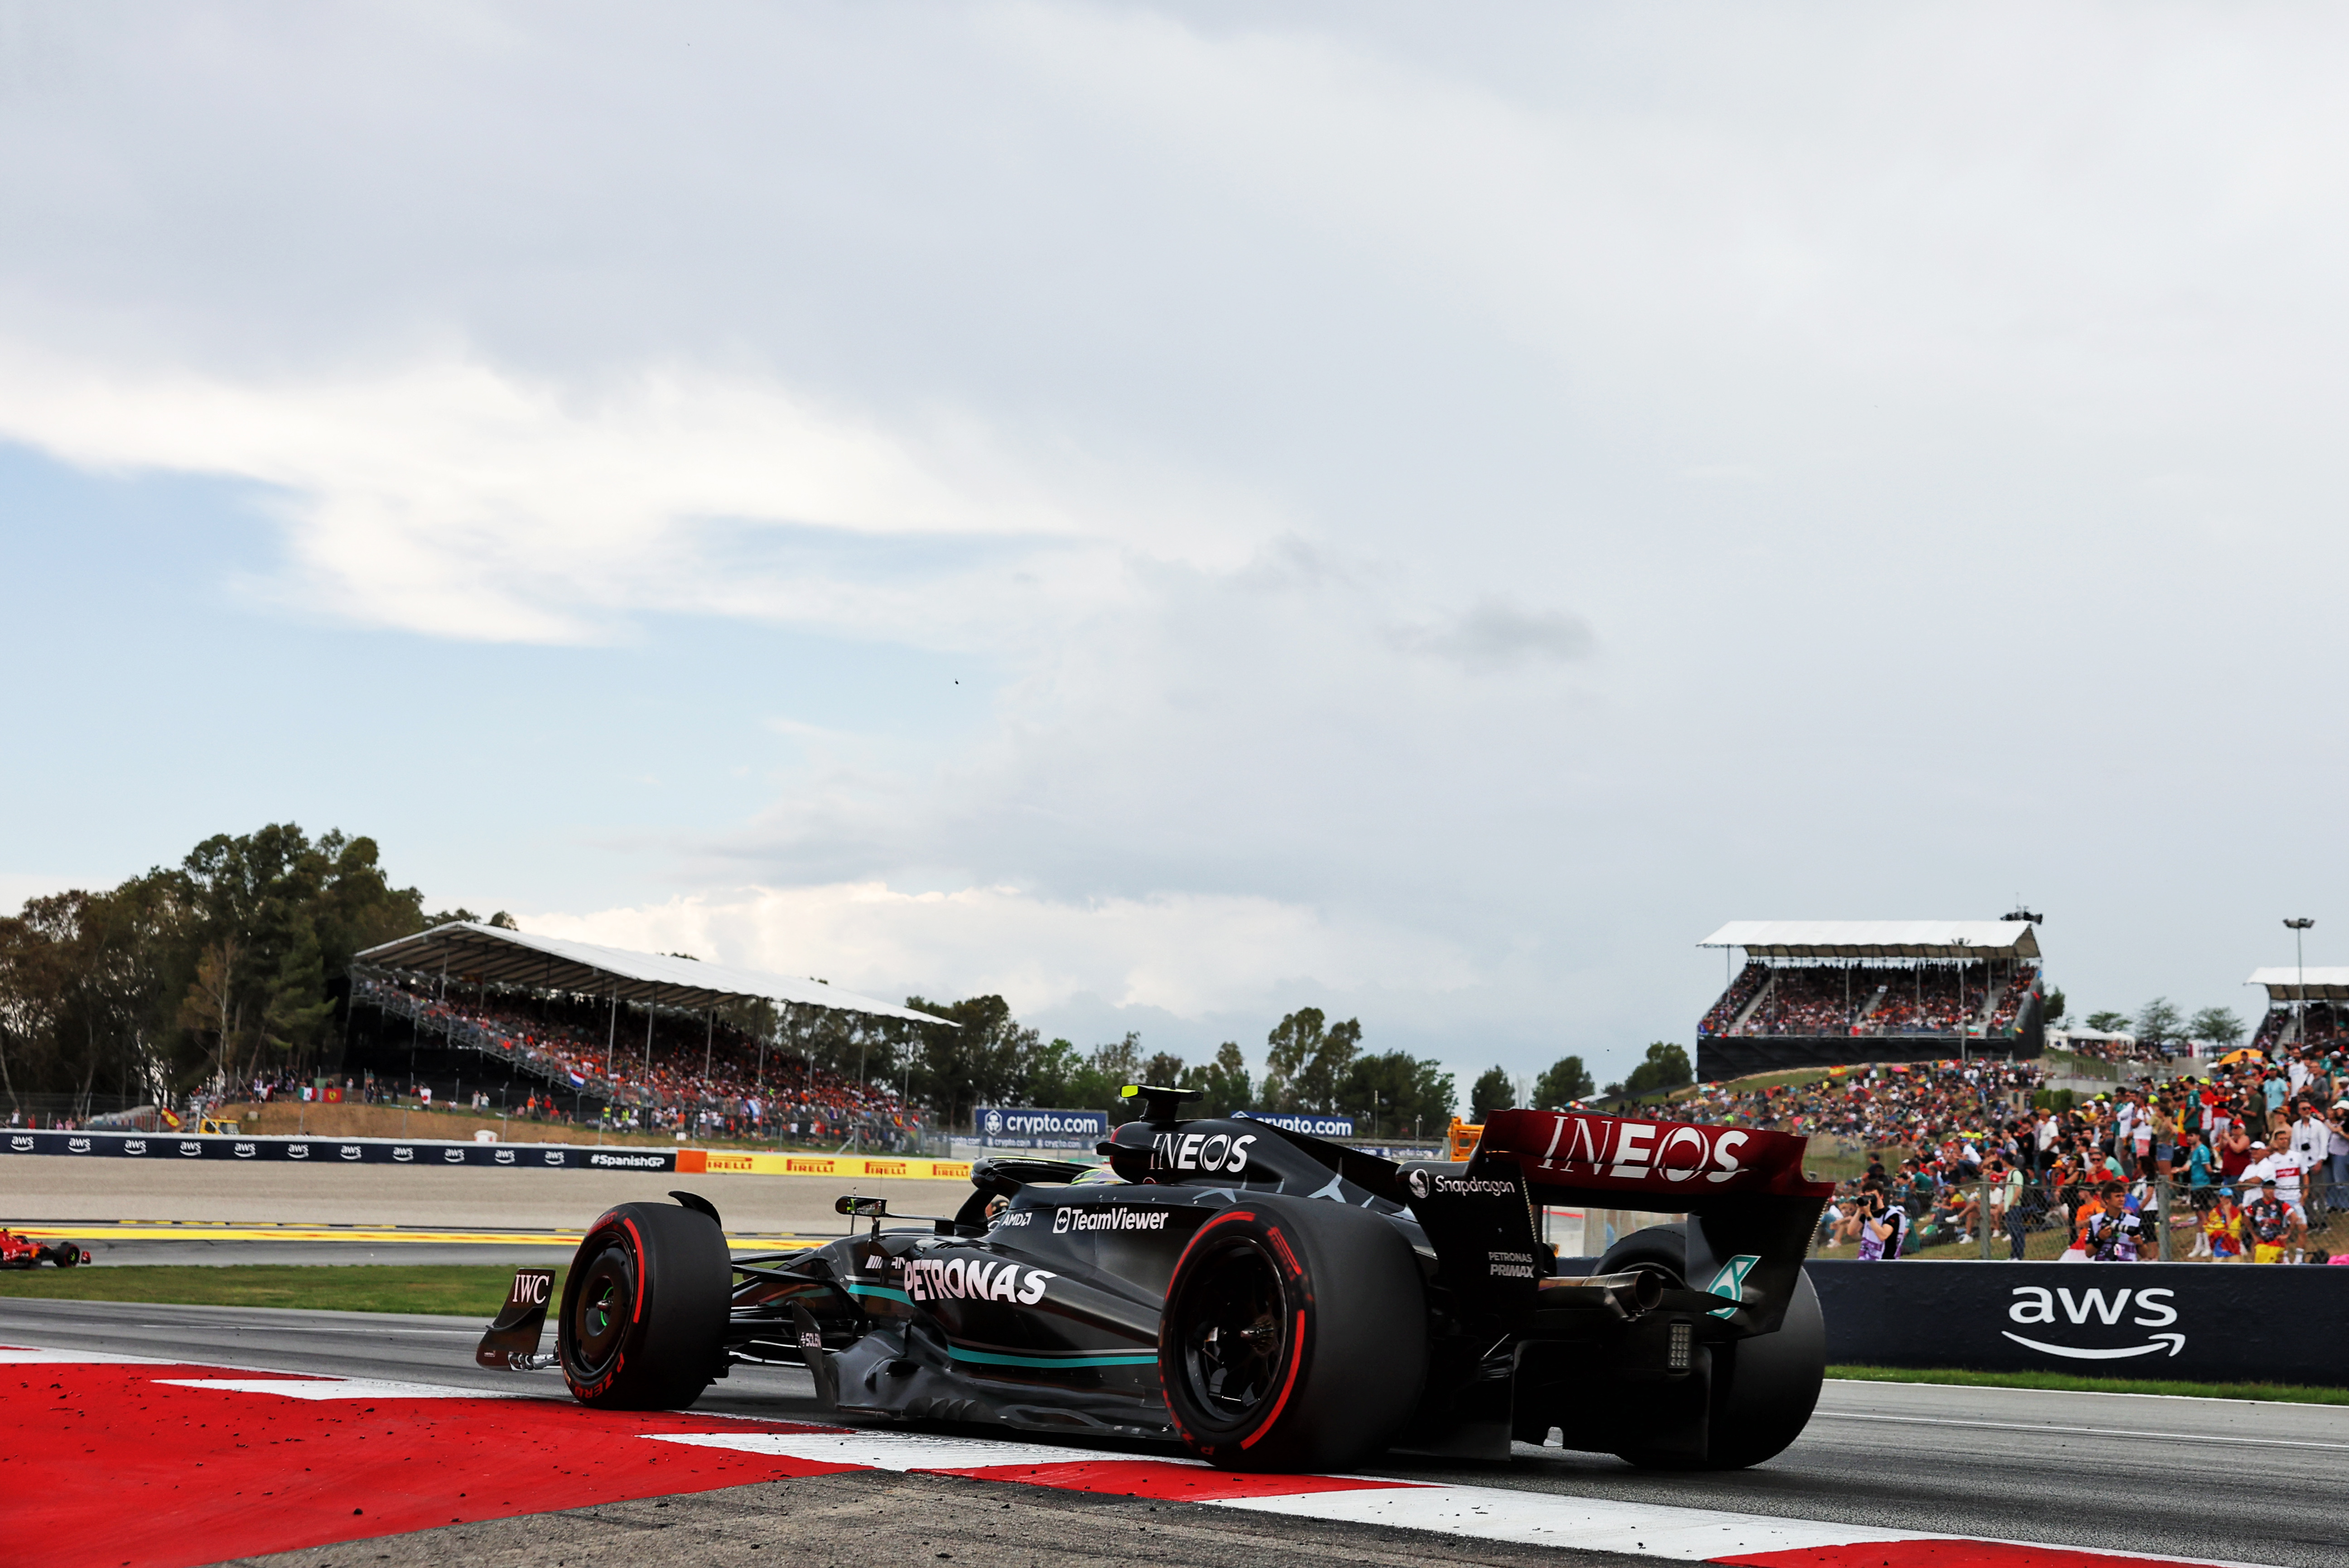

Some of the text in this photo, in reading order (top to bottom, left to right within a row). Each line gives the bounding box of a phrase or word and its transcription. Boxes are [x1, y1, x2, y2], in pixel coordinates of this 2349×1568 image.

[1007, 1114, 1098, 1134] crypto.com
[11, 1136, 34, 1145] aws
[69, 1138, 91, 1147] aws
[125, 1139, 147, 1149] aws
[180, 1141, 202, 1151] aws
[235, 1143, 256, 1152] aws
[288, 1144, 309, 1153] aws
[341, 1145, 362, 1155] aws
[393, 1147, 413, 1156] aws
[444, 1148, 464, 1158] aws
[1149, 1133, 1257, 1172] INEOS
[1538, 1116, 1750, 1182] INEOS
[495, 1150, 515, 1159] aws
[545, 1151, 564, 1160] aws
[590, 1154, 665, 1167] #SpanishGP
[787, 1159, 834, 1172] PIRELLI
[865, 1162, 906, 1174] PIRELLI
[933, 1164, 969, 1176] PIRELLI
[1435, 1175, 1515, 1196] Snapdragon
[1001, 1213, 1024, 1226] AMD
[1072, 1207, 1169, 1230] TeamViewer
[1488, 1252, 1533, 1263] PETRONAS
[1490, 1264, 1535, 1278] PRIMAX
[904, 1258, 1057, 1305] PETRONAS
[512, 1274, 549, 1304] IWC
[2008, 1286, 2177, 1327] aws
